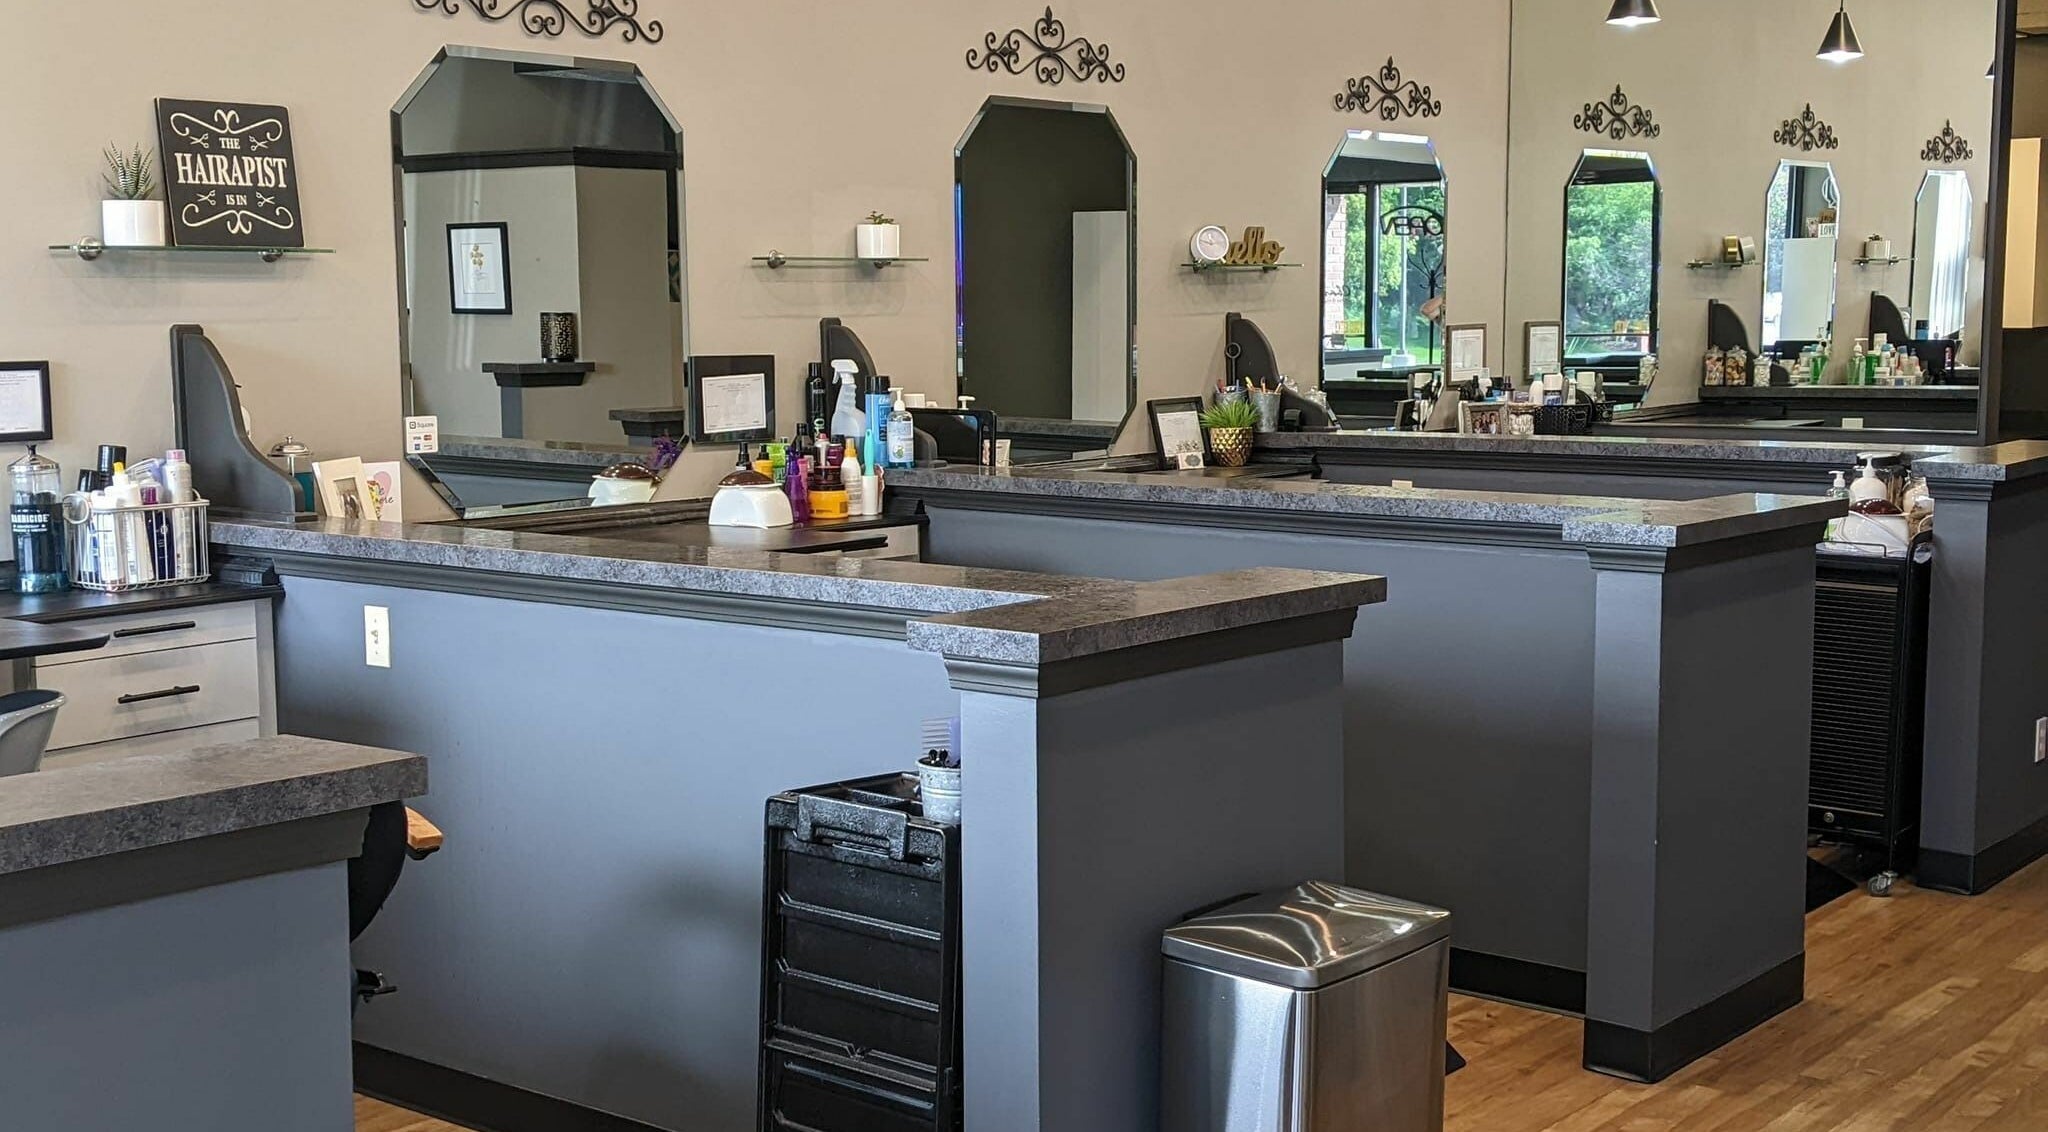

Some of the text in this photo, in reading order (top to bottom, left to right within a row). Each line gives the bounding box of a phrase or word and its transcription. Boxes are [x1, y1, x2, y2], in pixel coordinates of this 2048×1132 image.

[218, 137, 241, 150] THE
[174, 152, 288, 189] HAIRAPIST
[225, 194, 248, 206] IS IN
[1220, 226, 1285, 264] ello
